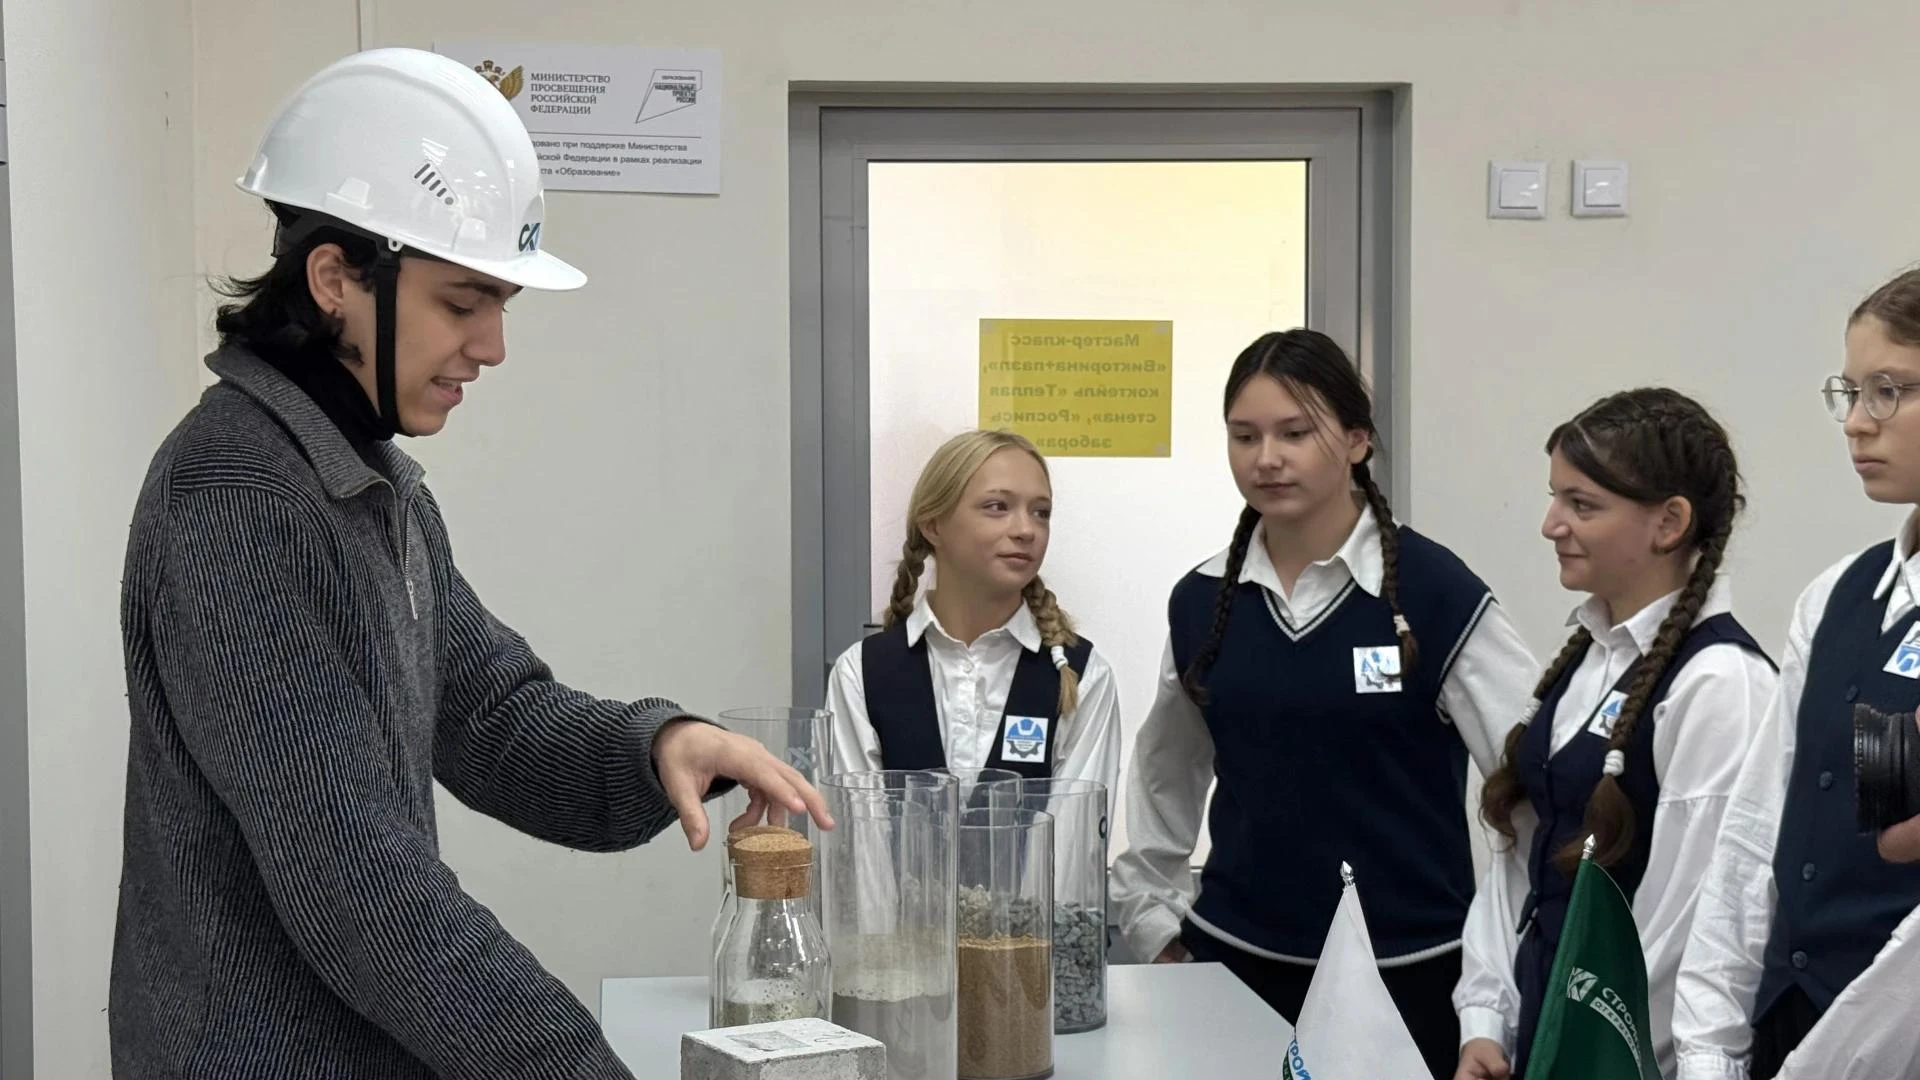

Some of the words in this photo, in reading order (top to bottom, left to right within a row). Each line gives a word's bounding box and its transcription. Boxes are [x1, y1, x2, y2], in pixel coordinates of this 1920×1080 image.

[530, 72, 611, 83] МИНИСТЕРСТВО
[530, 83, 606, 94] ПРОСВЕЩЕНИЯ
[530, 94, 597, 104] РОССИЙСКОЙ
[530, 104, 591, 115] ФЕДЕРАЦИИ
[562, 142, 578, 150] при
[580, 142, 625, 151] поддержке
[628, 142, 688, 152] Министерства
[563, 154, 611, 163] Федерации
[620, 157, 650, 165] рамках
[653, 157, 703, 167] реализации
[555, 167, 621, 177] «Образование»
